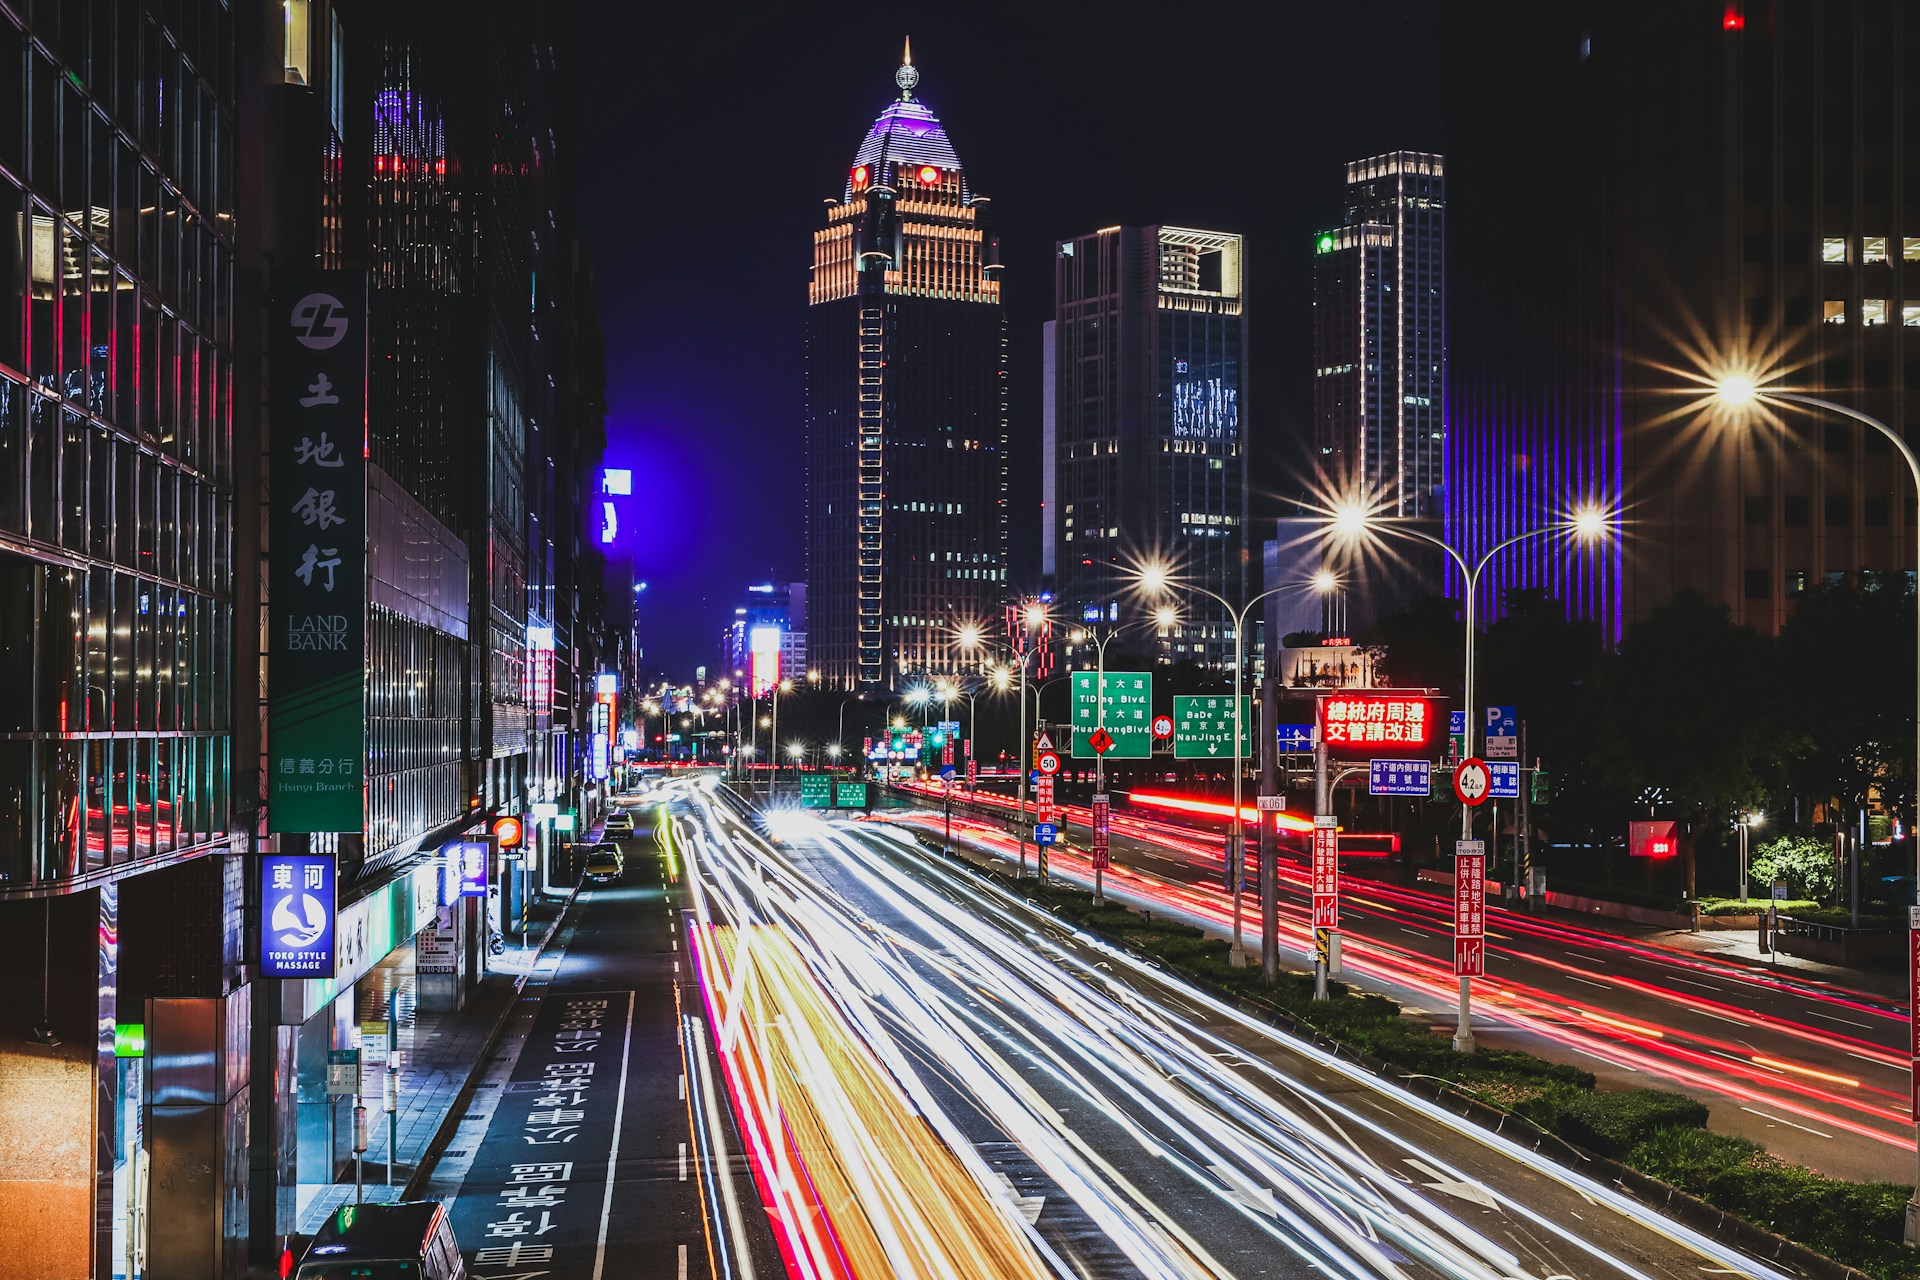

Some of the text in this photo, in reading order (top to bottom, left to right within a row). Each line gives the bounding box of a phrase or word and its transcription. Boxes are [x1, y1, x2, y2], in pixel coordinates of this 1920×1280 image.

[291, 372, 346, 592] 土地銀行
[288, 614, 348, 633] LAND
[288, 633, 348, 651] BANK
[1079, 695, 1146, 705] TiDng Blvd.
[1190, 698, 1234, 709] 八德路
[1186, 711, 1212, 719] BaDe
[1327, 701, 1425, 722] 總統府周邊
[1487, 707, 1502, 726] P
[1181, 721, 1243, 731] 南京東
[1327, 722, 1424, 742] 交管請改道
[1177, 733, 1222, 743] NanJing
[279, 758, 354, 774] 信義分行
[1042, 759, 1055, 769] 50
[1372, 762, 1428, 773] 地下道內側車道
[278, 782, 355, 793] Hsinyi Branch
[1372, 774, 1428, 785] 專用號誌
[1269, 797, 1284, 809] 061
[1316, 829, 1325, 893] 准行駛環東大道
[1325, 829, 1335, 893] 基隆路地下道僅
[272, 863, 325, 890] 東河
[1459, 857, 1470, 934] 止併入平面車道
[1471, 857, 1482, 934] 基隆路地下道禁
[269, 951, 327, 960] TOKO STYLE
[276, 961, 321, 970] MASSAGE
[523, 1062, 595, 1145] 公車停靠區
